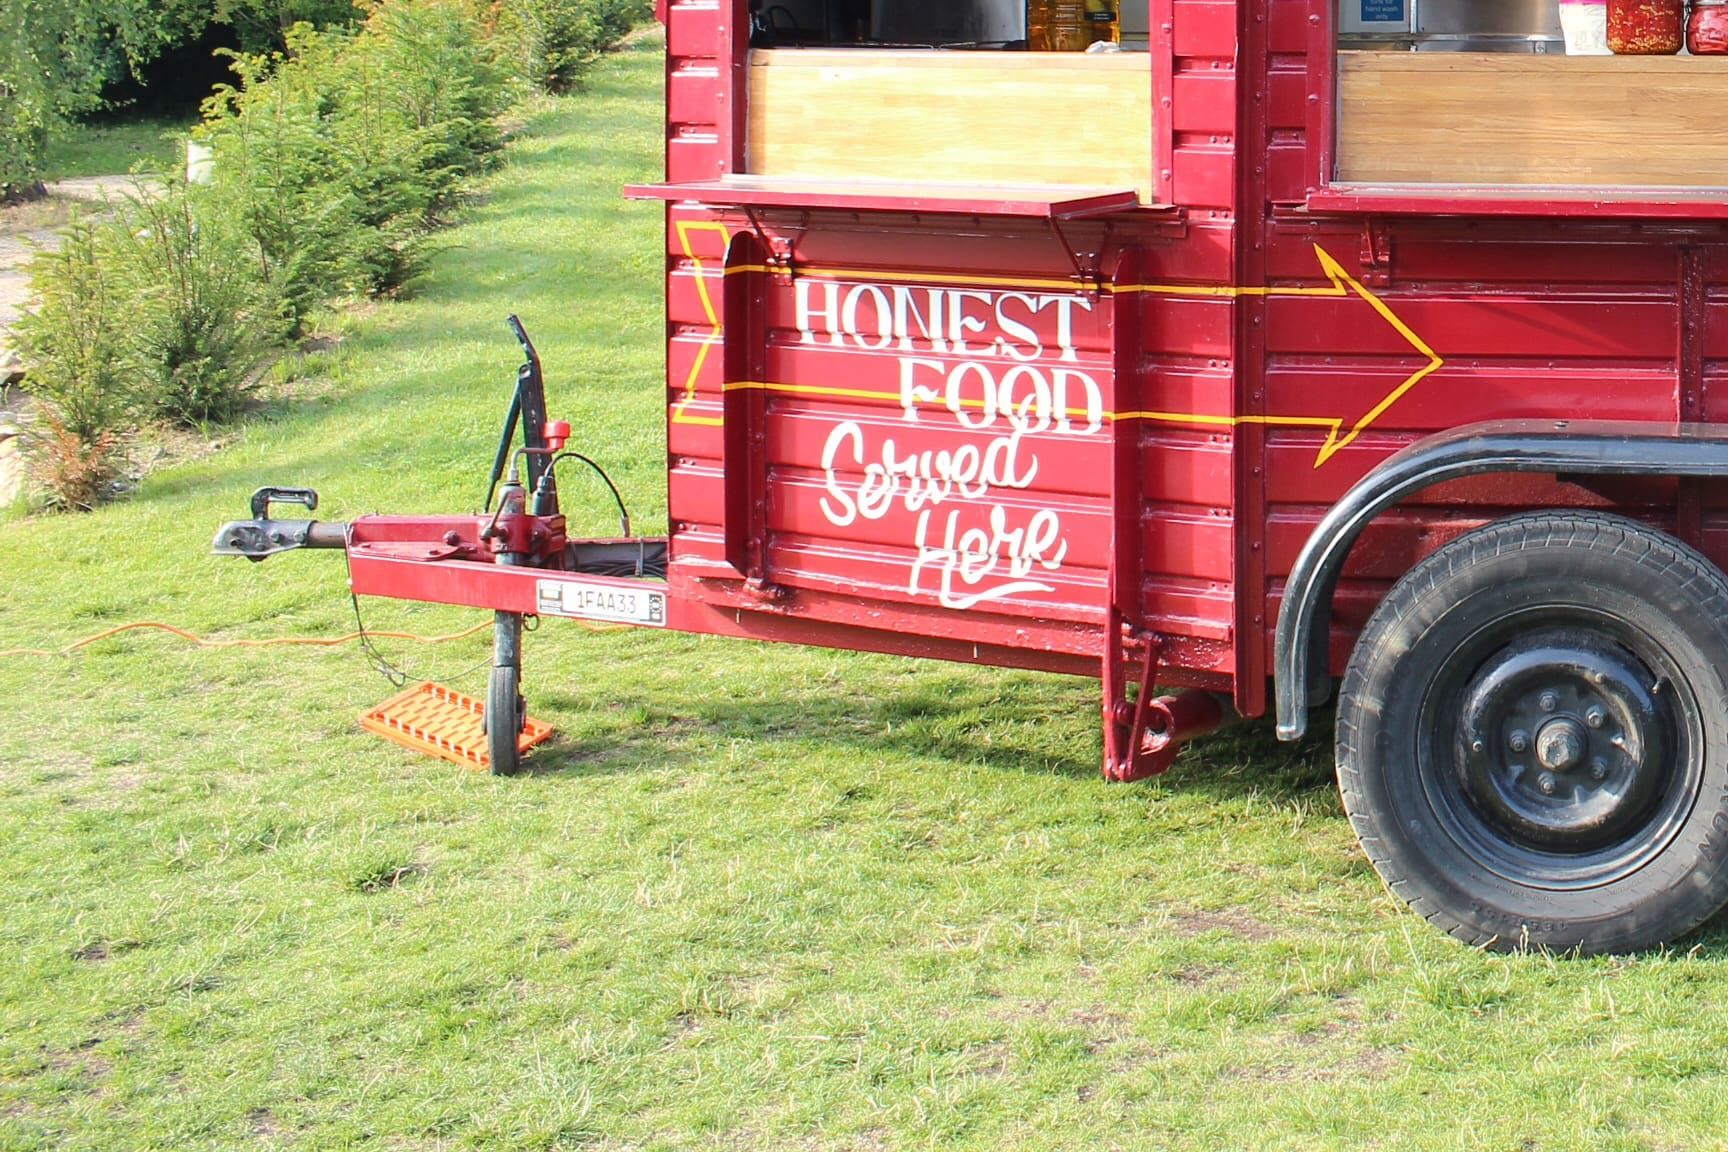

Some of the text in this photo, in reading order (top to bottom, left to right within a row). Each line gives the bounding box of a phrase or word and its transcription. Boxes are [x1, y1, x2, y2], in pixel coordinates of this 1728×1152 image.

[794, 282, 1092, 363] HONEST
[898, 357, 1103, 436] FOOD
[819, 394, 1038, 527] Served
[907, 504, 1068, 609] Here
[577, 589, 636, 615] 1FAA33
